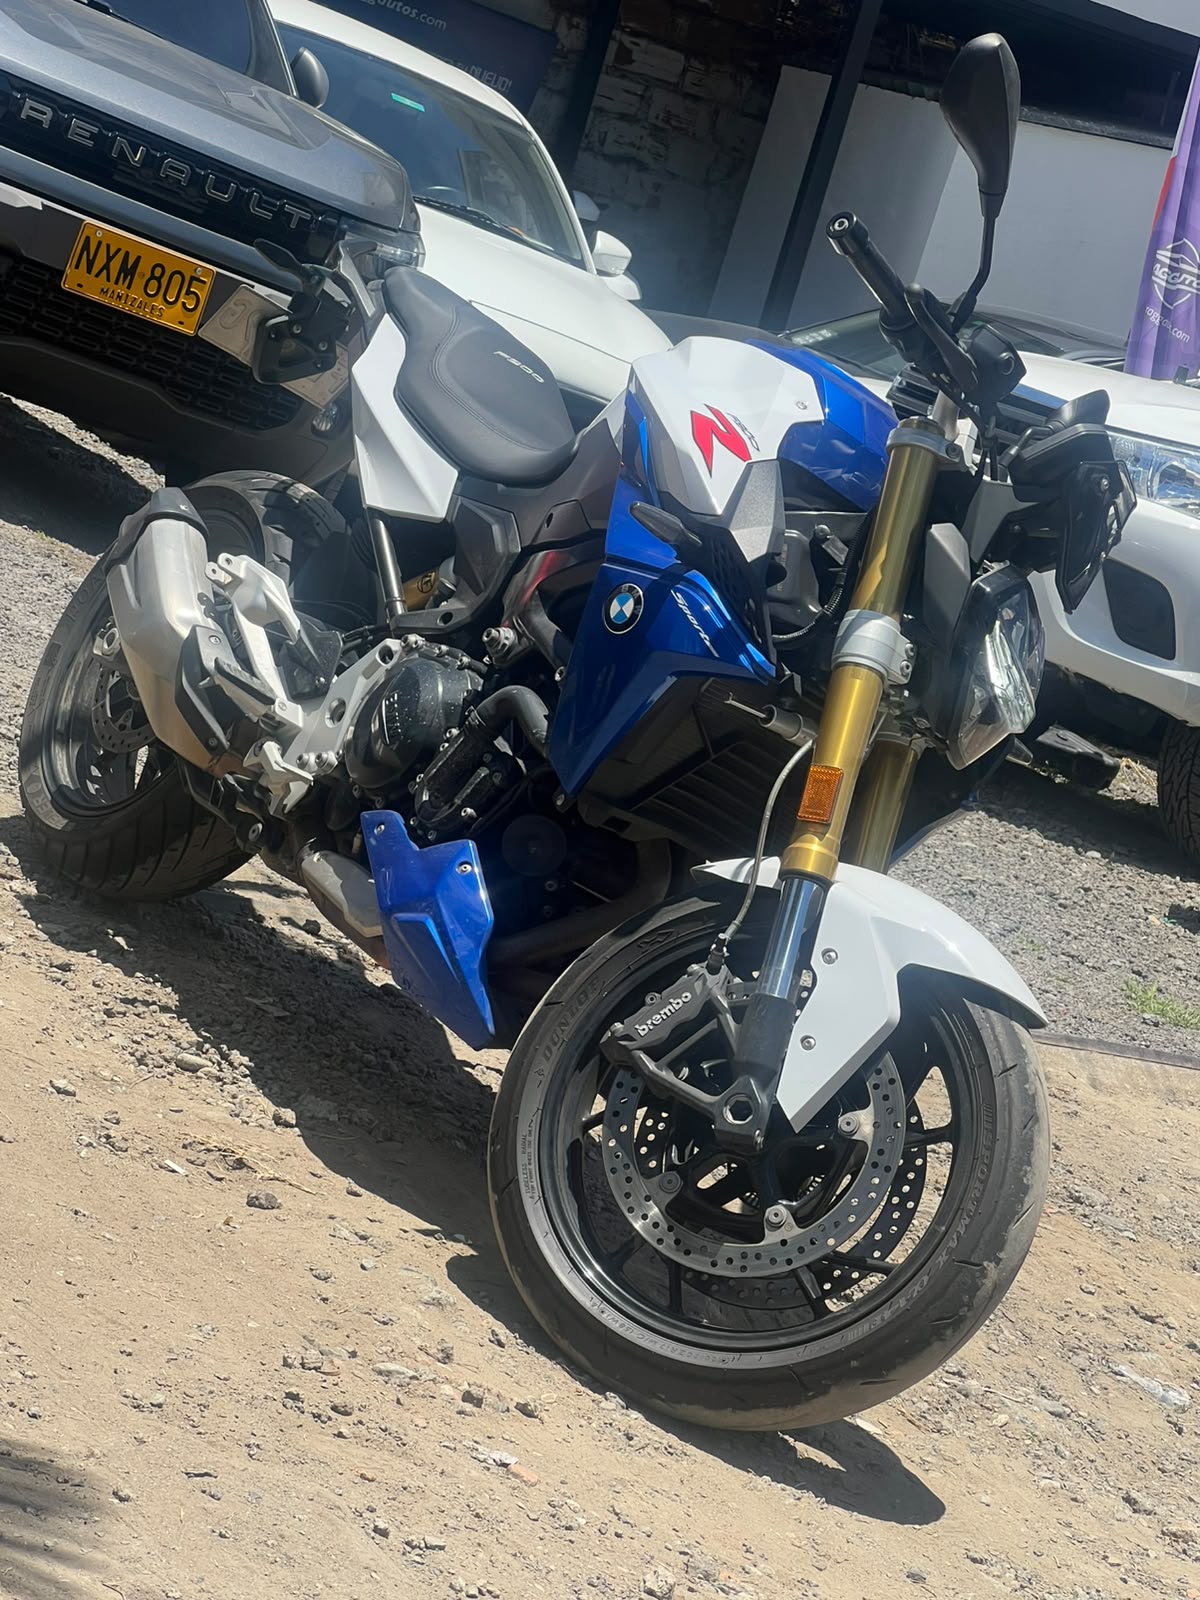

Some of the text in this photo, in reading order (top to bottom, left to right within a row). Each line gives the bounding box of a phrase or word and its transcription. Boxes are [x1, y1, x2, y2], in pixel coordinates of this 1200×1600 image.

[361, 0, 447, 30] autos.com
[20, 97, 313, 230] RENAULT
[74, 236, 207, 313] NXM 805
[100, 286, 166, 318] MANIZALES
[634, 991, 692, 1037] brembo
